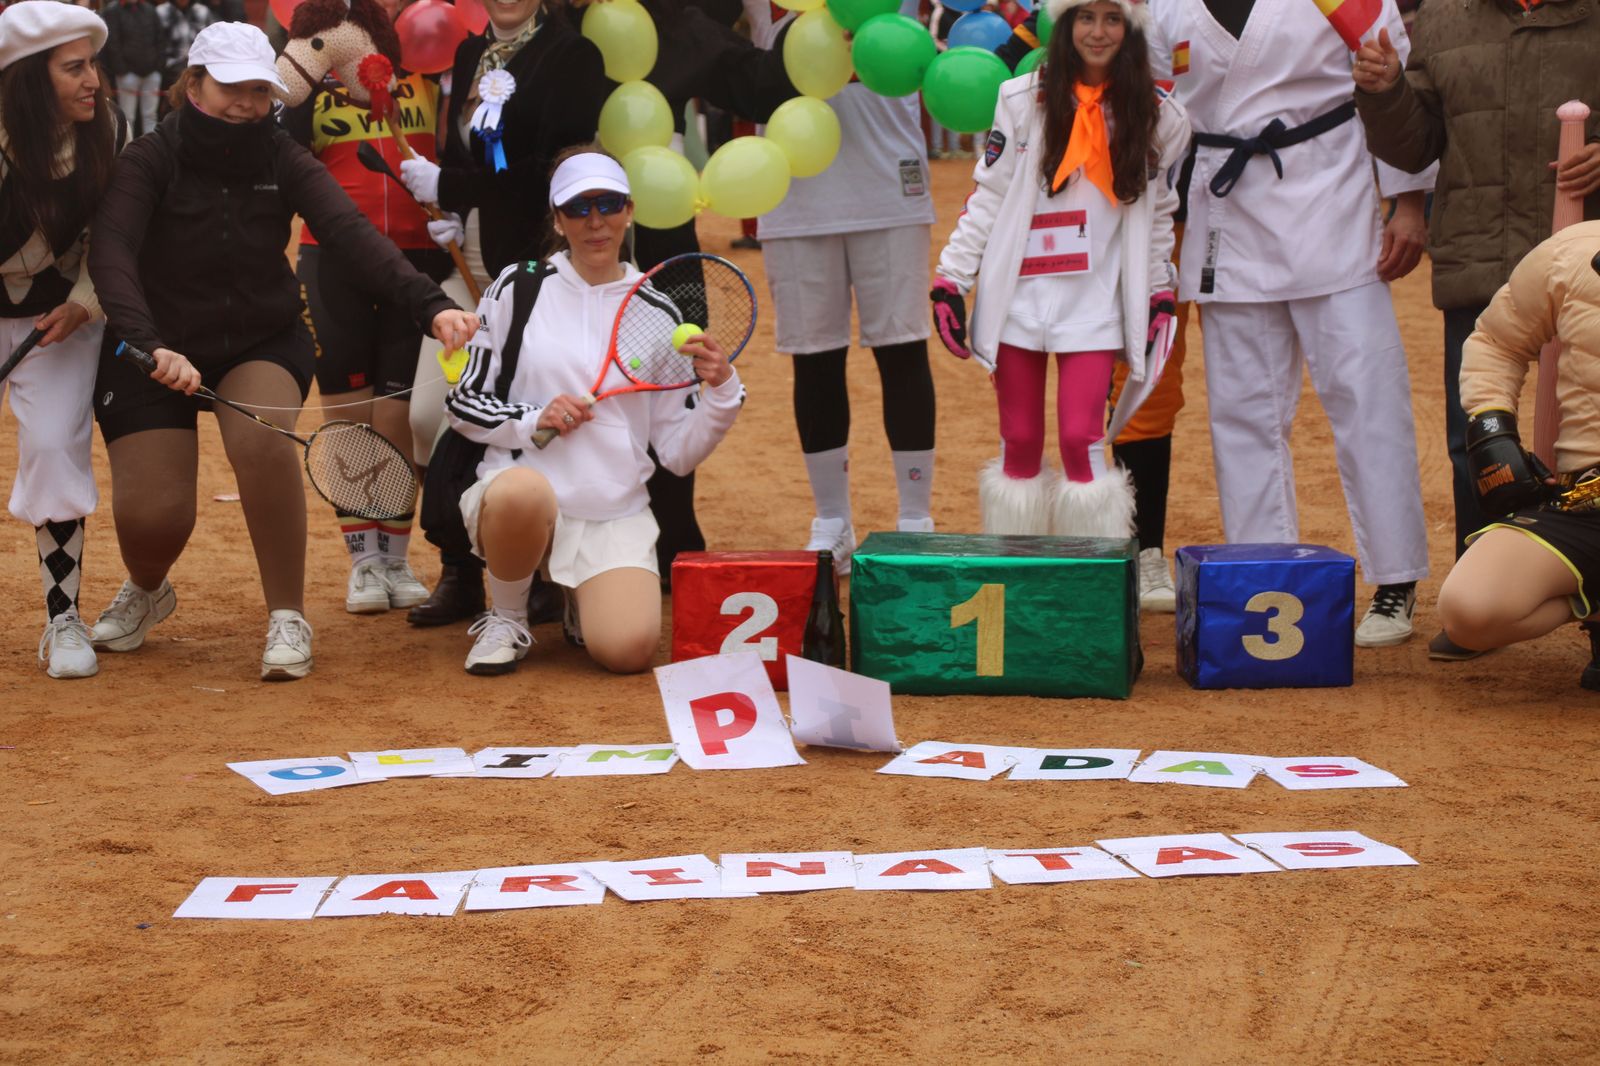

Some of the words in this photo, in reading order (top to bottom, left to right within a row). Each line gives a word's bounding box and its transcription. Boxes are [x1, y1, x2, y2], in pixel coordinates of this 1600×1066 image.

[357, 106, 426, 133] VIMA
[719, 591, 779, 661] 2
[950, 583, 1005, 676] 1
[1241, 591, 1304, 660] 3
[227, 841, 1368, 903] FARINATAS
